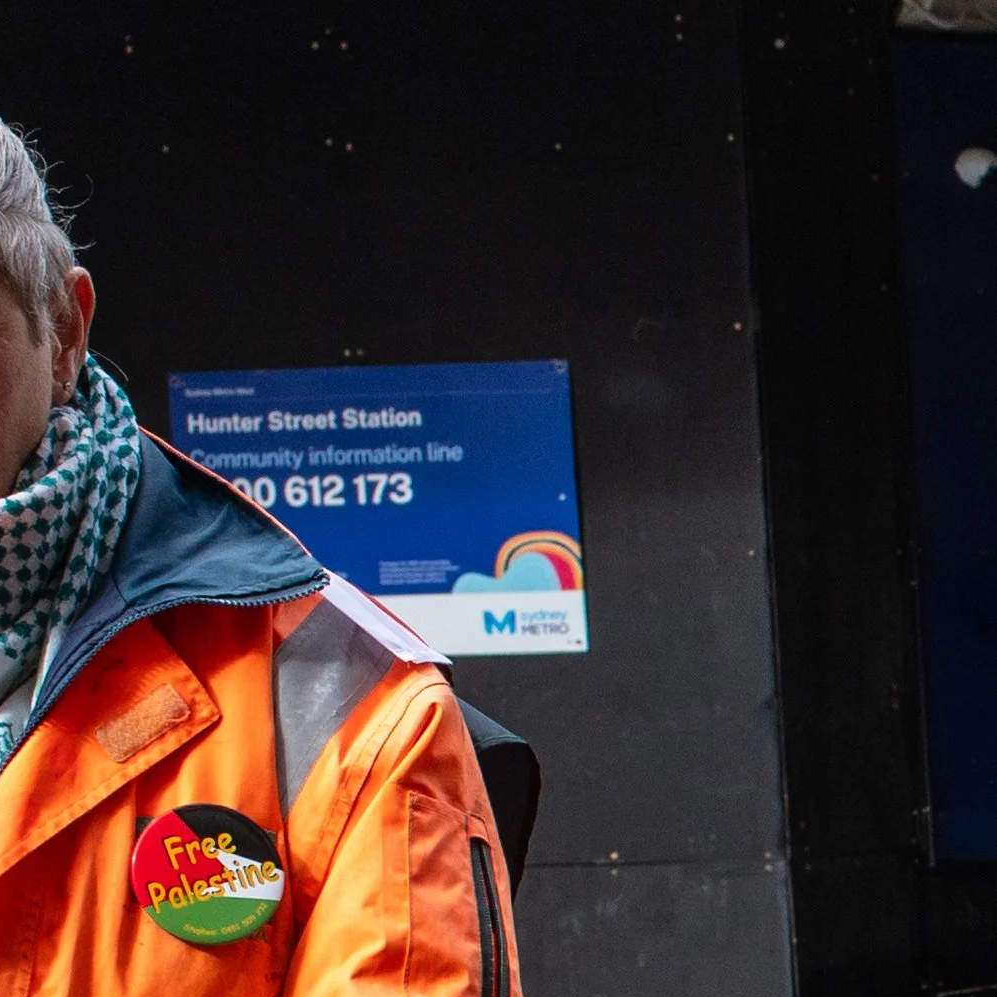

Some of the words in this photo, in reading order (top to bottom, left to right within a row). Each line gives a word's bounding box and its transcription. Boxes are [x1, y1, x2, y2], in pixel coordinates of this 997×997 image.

[187, 413, 263, 433] Hunter
[267, 410, 336, 432] Street
[341, 408, 422, 429] Station
[191, 449, 304, 470] Community
[308, 444, 422, 466] information
[427, 441, 464, 463] line
[284, 474, 345, 507] 612
[353, 472, 414, 505] 173
[521, 623, 570, 636] METRO
[163, 832, 237, 870] Free
[147, 861, 280, 914] Palestine
